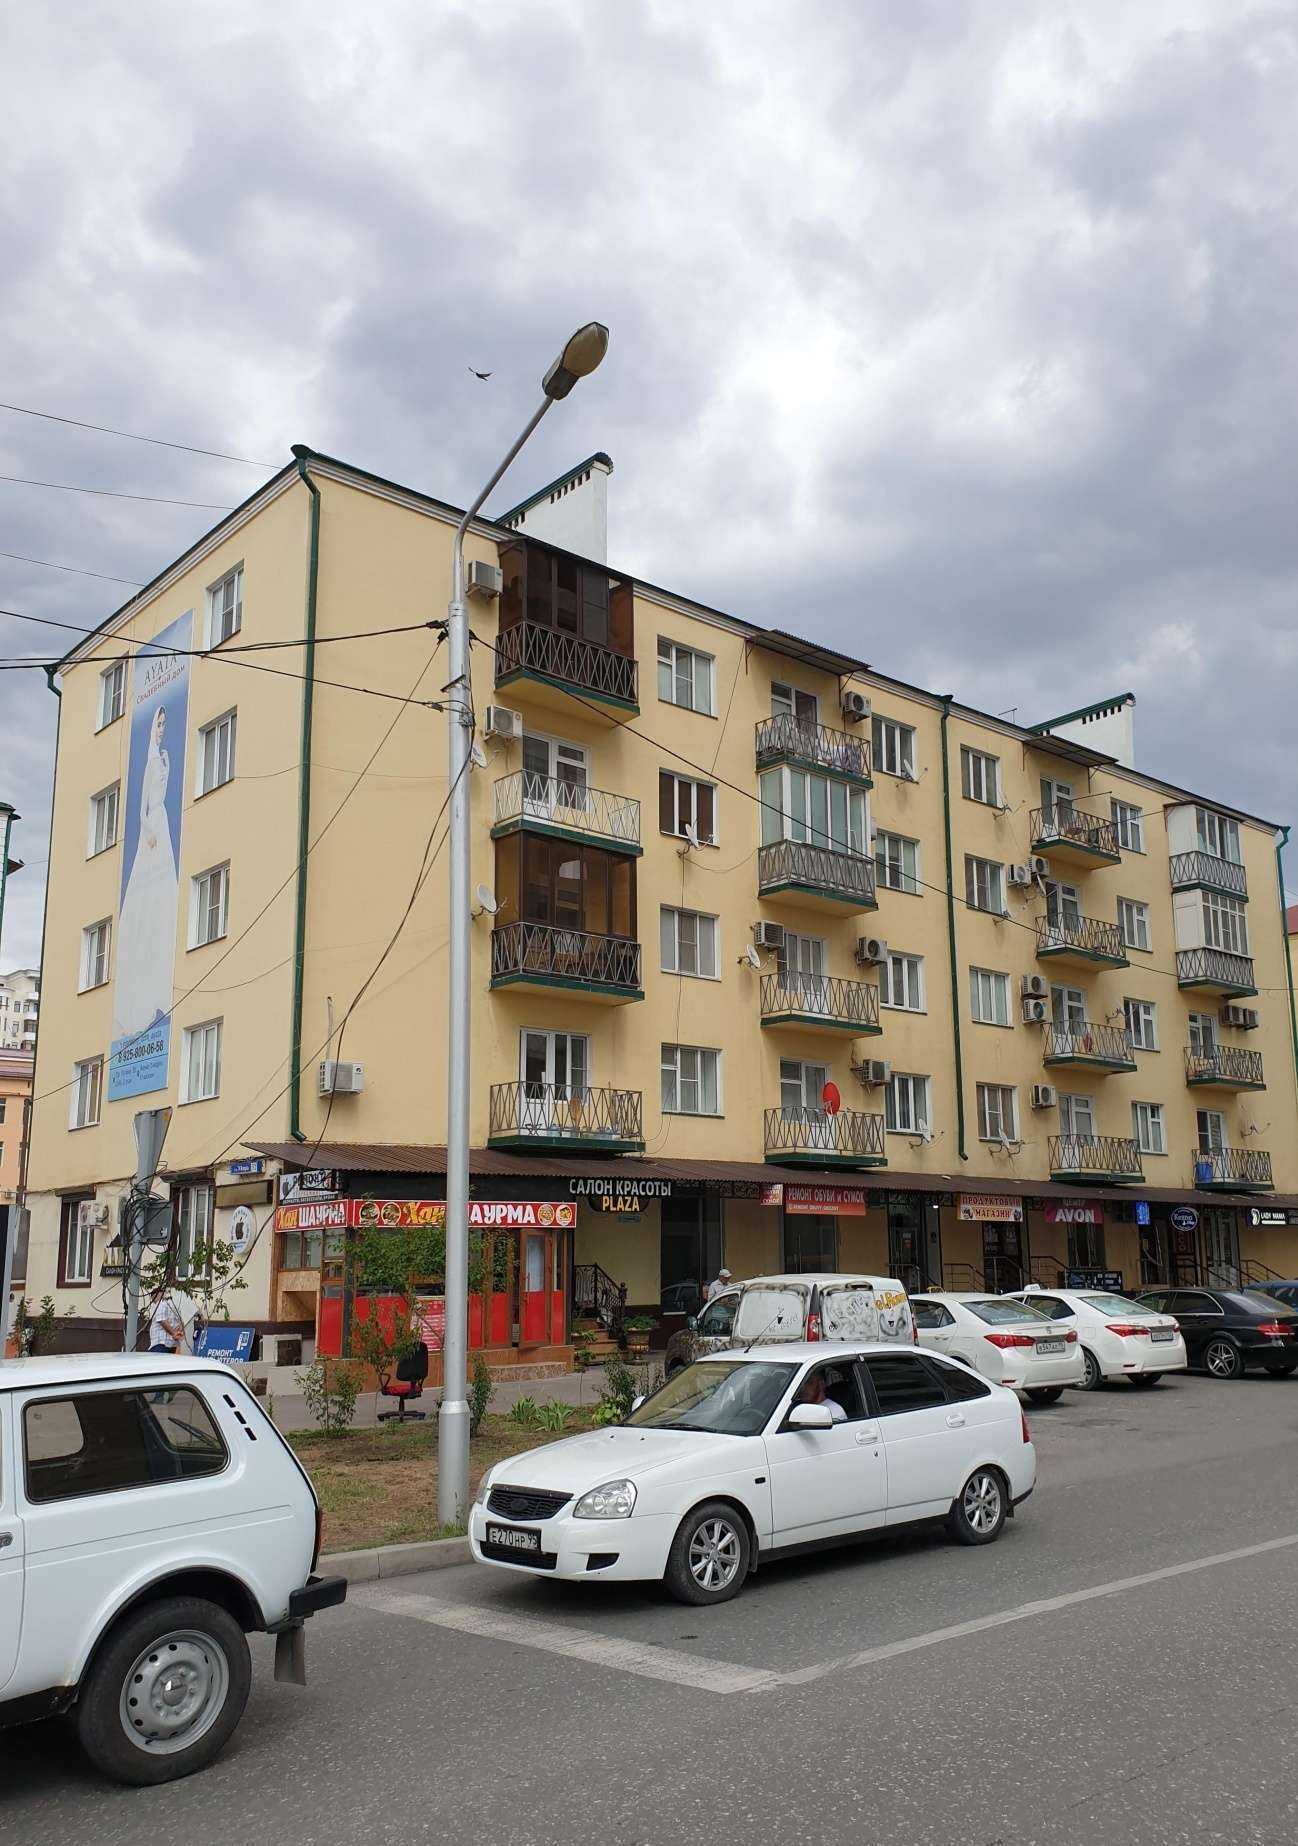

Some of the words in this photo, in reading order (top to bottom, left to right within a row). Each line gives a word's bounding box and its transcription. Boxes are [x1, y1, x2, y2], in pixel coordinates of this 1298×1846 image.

[569, 1179, 613, 1195] САЛОН
[616, 1181, 672, 1196] КРАСОТЫ
[787, 1187, 812, 1200] РЕМОНТ
[602, 1196, 641, 1212] PLAZA
[298, 1203, 346, 1227] ШАУРМА
[468, 1204, 536, 1224] АУРМА
[975, 1208, 1010, 1218] МАГАЗИН
[1055, 1209, 1095, 1223] AVON
[207, 1348, 234, 1357] РЕМОНТ
